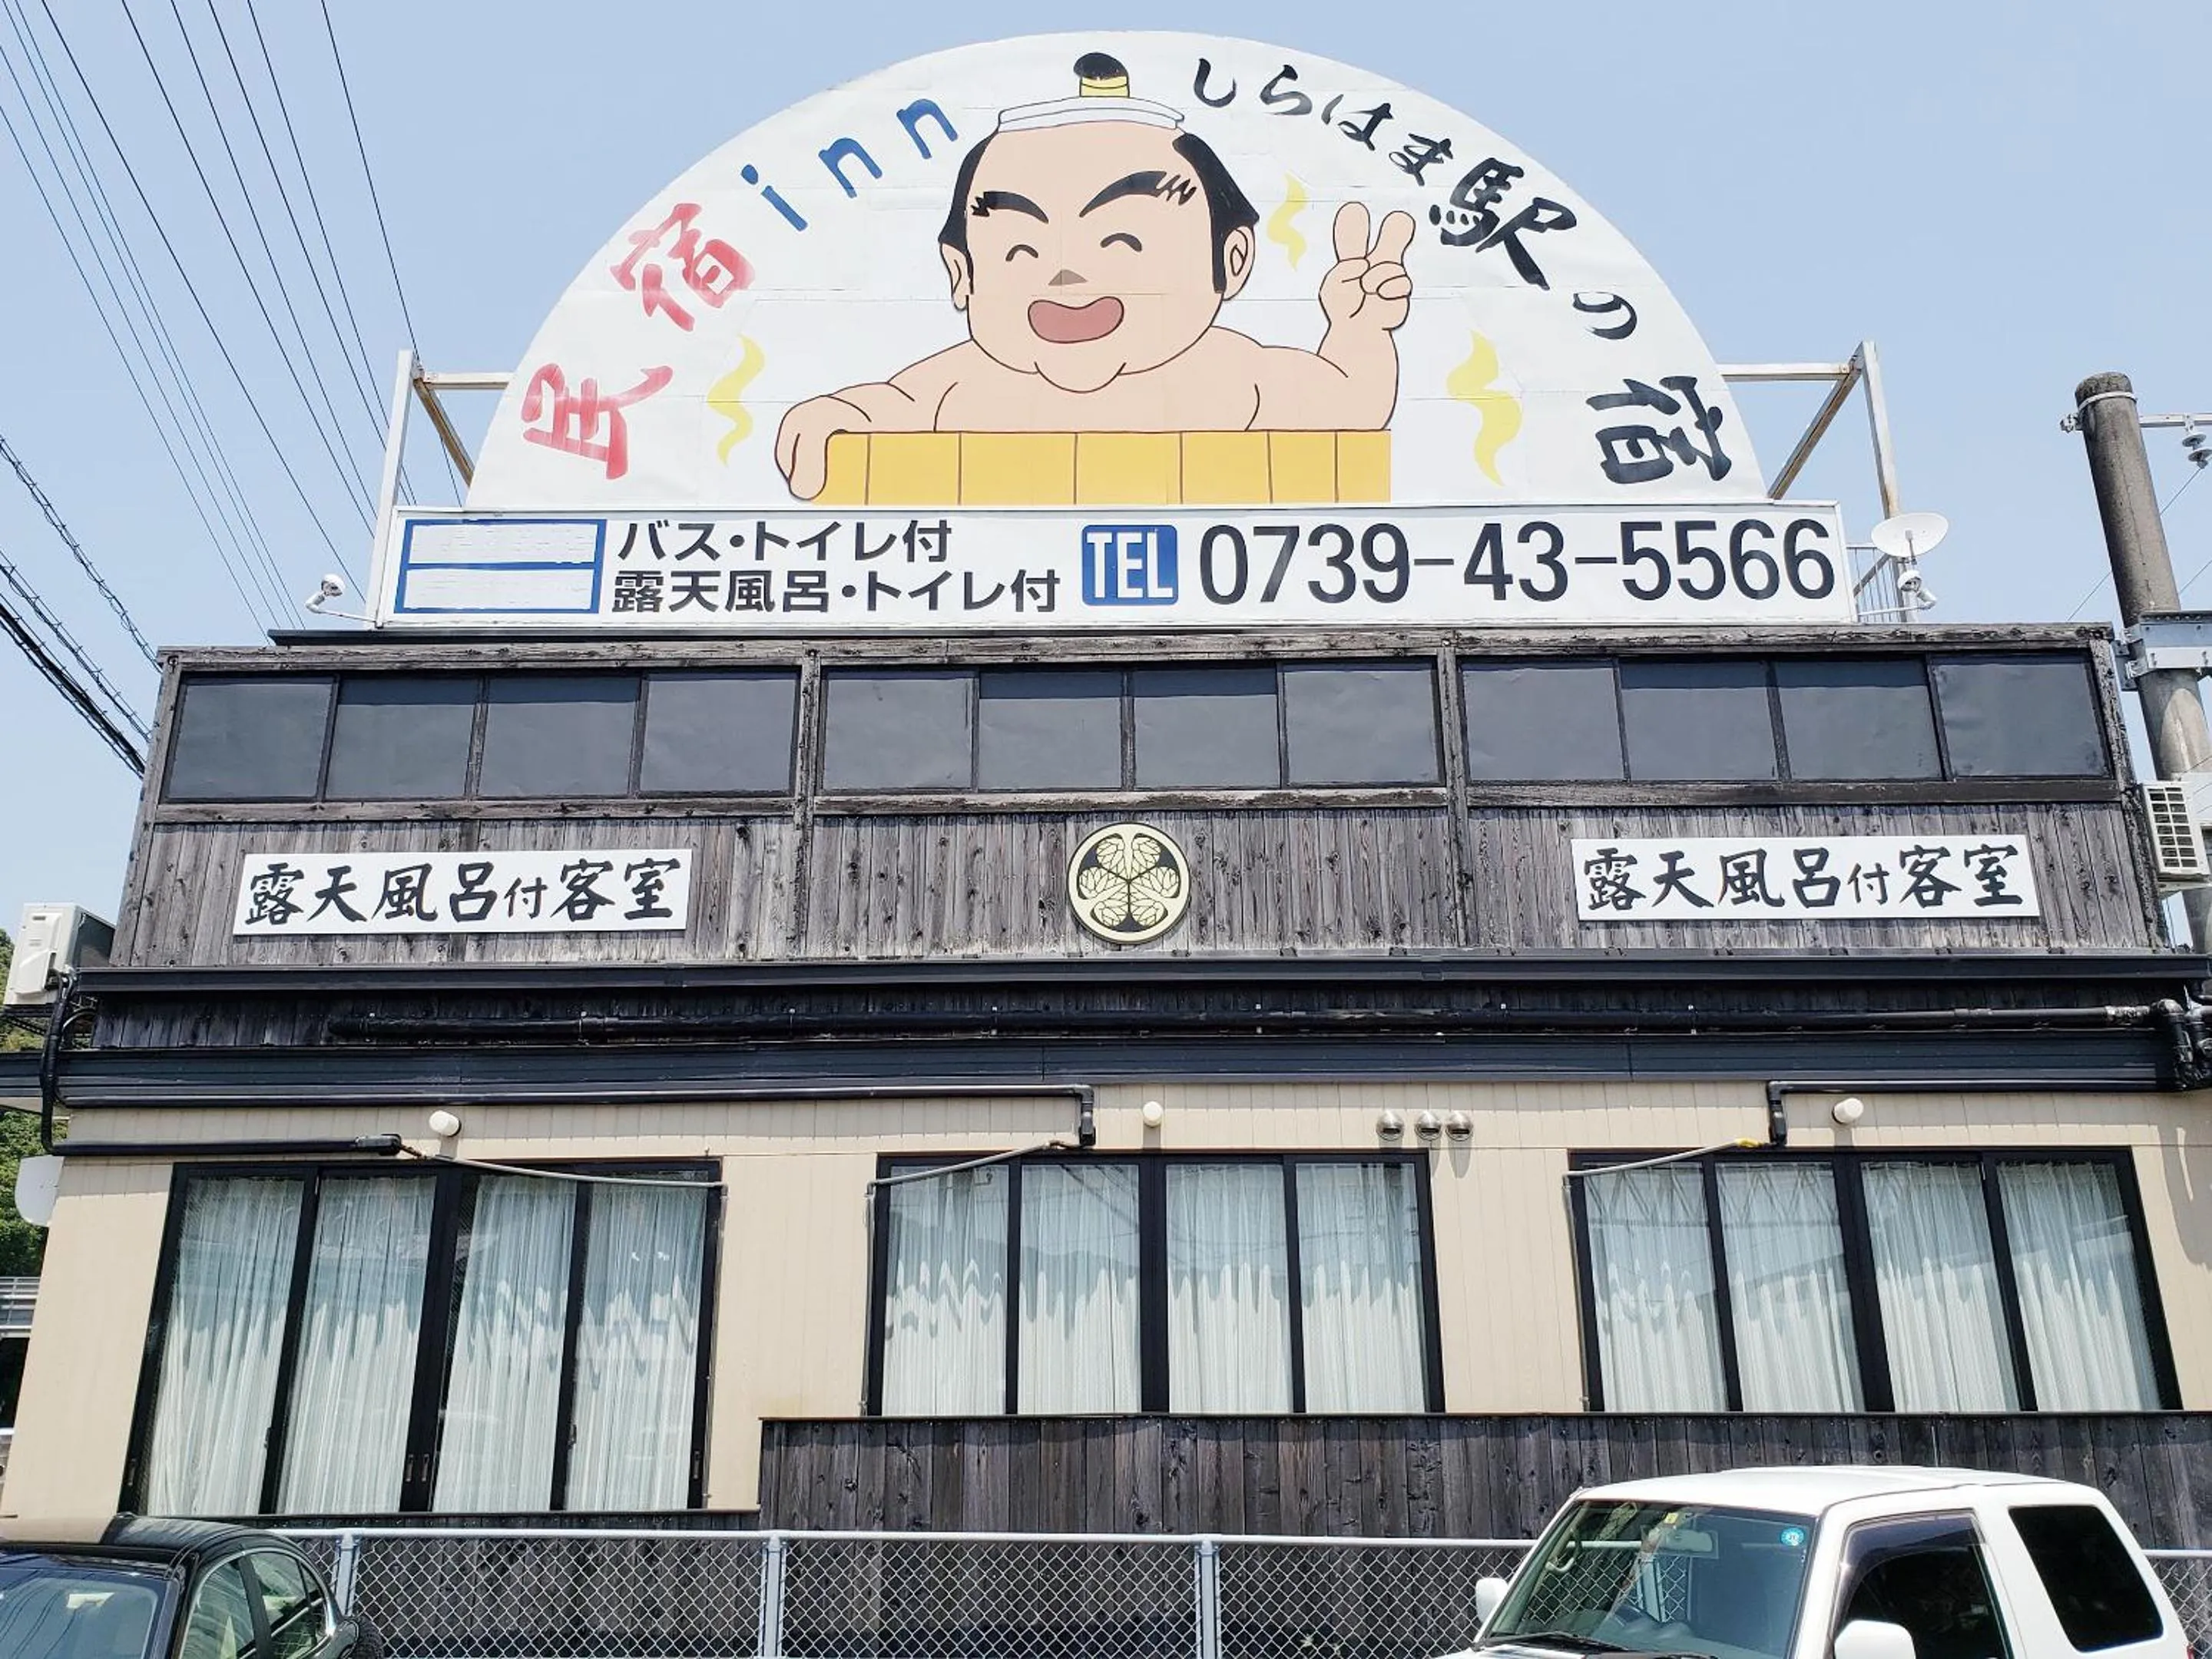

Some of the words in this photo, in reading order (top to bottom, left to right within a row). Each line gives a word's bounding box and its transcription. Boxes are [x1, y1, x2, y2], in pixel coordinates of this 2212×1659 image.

[1190, 58, 1732, 484] しらはま駅の宿
[522, 203, 756, 480] 民宿
[617, 518, 952, 564] バス・トイレ付
[1085, 531, 1175, 599] TEL
[1199, 518, 1836, 606] 0739-43-5566
[611, 568, 1061, 614] 露天風呂・トイレ付
[244, 857, 681, 926] 露天風呂付客室
[1583, 843, 2024, 912] 露天風呂付客室
